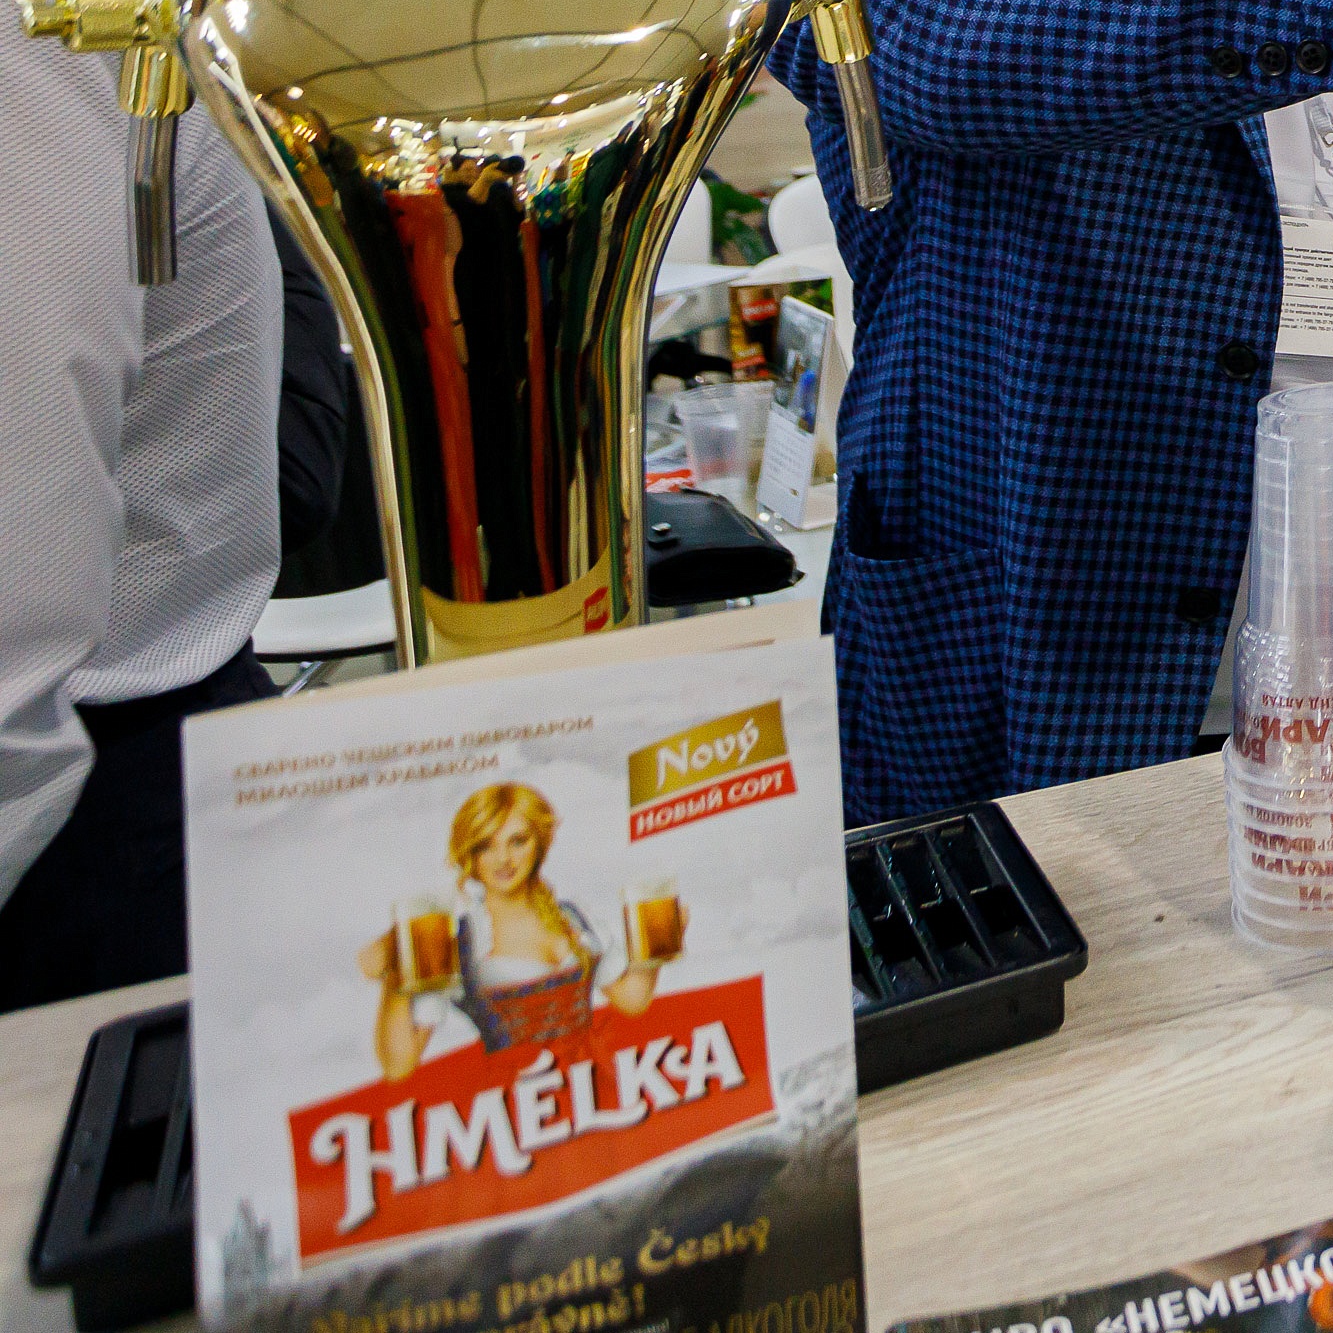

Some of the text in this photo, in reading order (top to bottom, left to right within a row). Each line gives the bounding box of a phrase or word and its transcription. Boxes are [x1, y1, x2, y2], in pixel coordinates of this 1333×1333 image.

[460, 715, 595, 749] ПИВОВАРОМ
[1262, 694, 1304, 709] АЛТАЯ
[656, 717, 760, 792] Nový
[636, 769, 785, 836] НОВЫЙ СОРТ
[307, 1020, 749, 1234] HMÉLKA
